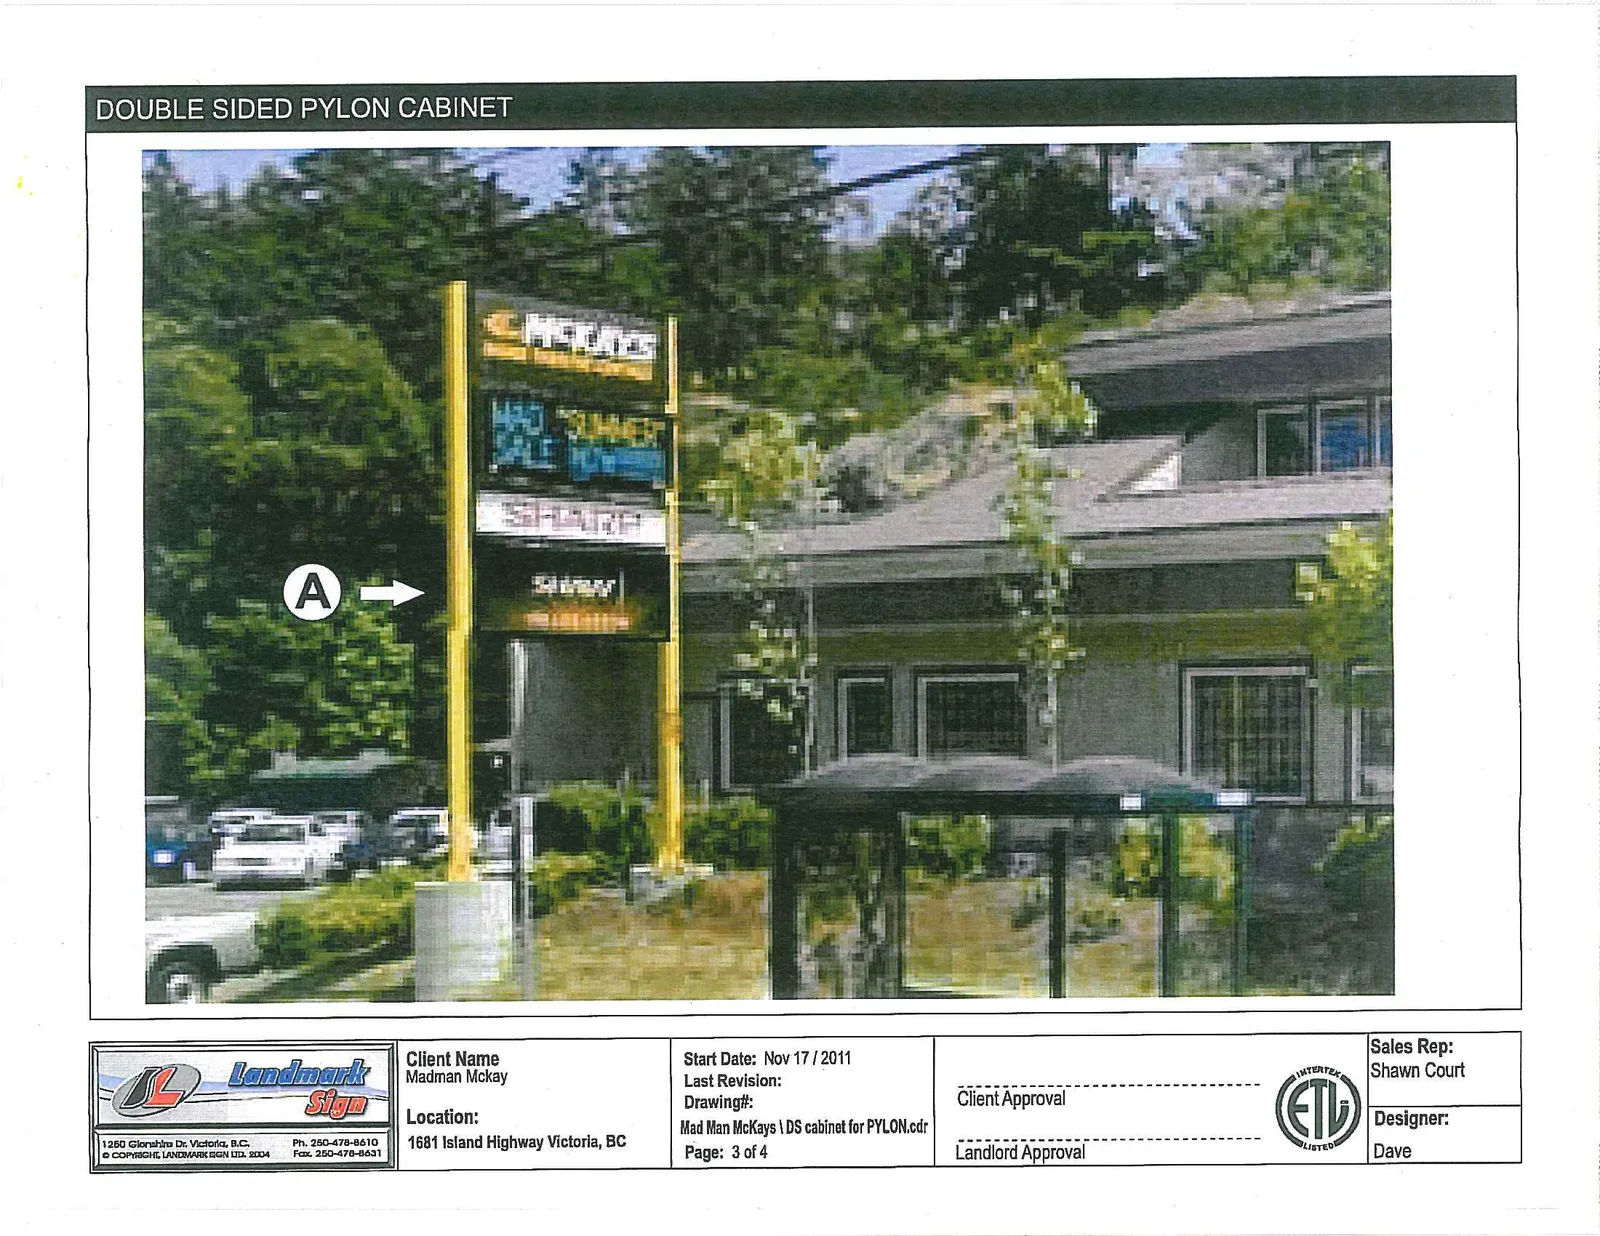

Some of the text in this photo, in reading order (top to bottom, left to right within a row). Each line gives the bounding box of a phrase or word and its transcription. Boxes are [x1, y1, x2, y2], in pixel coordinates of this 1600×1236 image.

[96, 96, 513, 120] DOUBLE SIDED PYLON CABINET
[1370, 1037, 1453, 1058] Sales Rep:
[406, 1050, 500, 1068] Client Name
[683, 1050, 851, 1067] Start Date: Nov 17 / 2011
[228, 1059, 370, 1087] Landmark
[405, 1068, 508, 1087] Madman Mckay
[1296, 1066, 1341, 1078] INTERTEK
[1370, 1061, 1466, 1079] Shawn Court
[684, 1073, 782, 1088] Last Revision:
[305, 1088, 368, 1119] Sign
[684, 1093, 753, 1113] Drawing#:
[957, 1089, 1066, 1111] Client Approval
[406, 1108, 479, 1125] Location:
[1374, 1109, 1449, 1130] Designer:
[680, 1119, 704, 1135] Mad
[706, 1119, 731, 1135] Man
[732, 1119, 777, 1138] McKays
[785, 1119, 803, 1135] DS
[804, 1118, 847, 1135] cabinet
[848, 1118, 865, 1135] for
[867, 1118, 929, 1135] PYLON.cdr
[176, 1140, 188, 1148] Dr.
[190, 1140, 228, 1148] Victoria,
[293, 1139, 378, 1147] Ph. 250-478-8610
[407, 1134, 627, 1152] 1681 Island Highway Victoria, BC
[1303, 1142, 1335, 1151] LISTED
[1373, 1142, 1412, 1159] Dave
[294, 1150, 312, 1158] Fax.
[685, 1143, 768, 1163] Page: 3 of 4
[955, 1143, 1086, 1165] Landlord Approval
